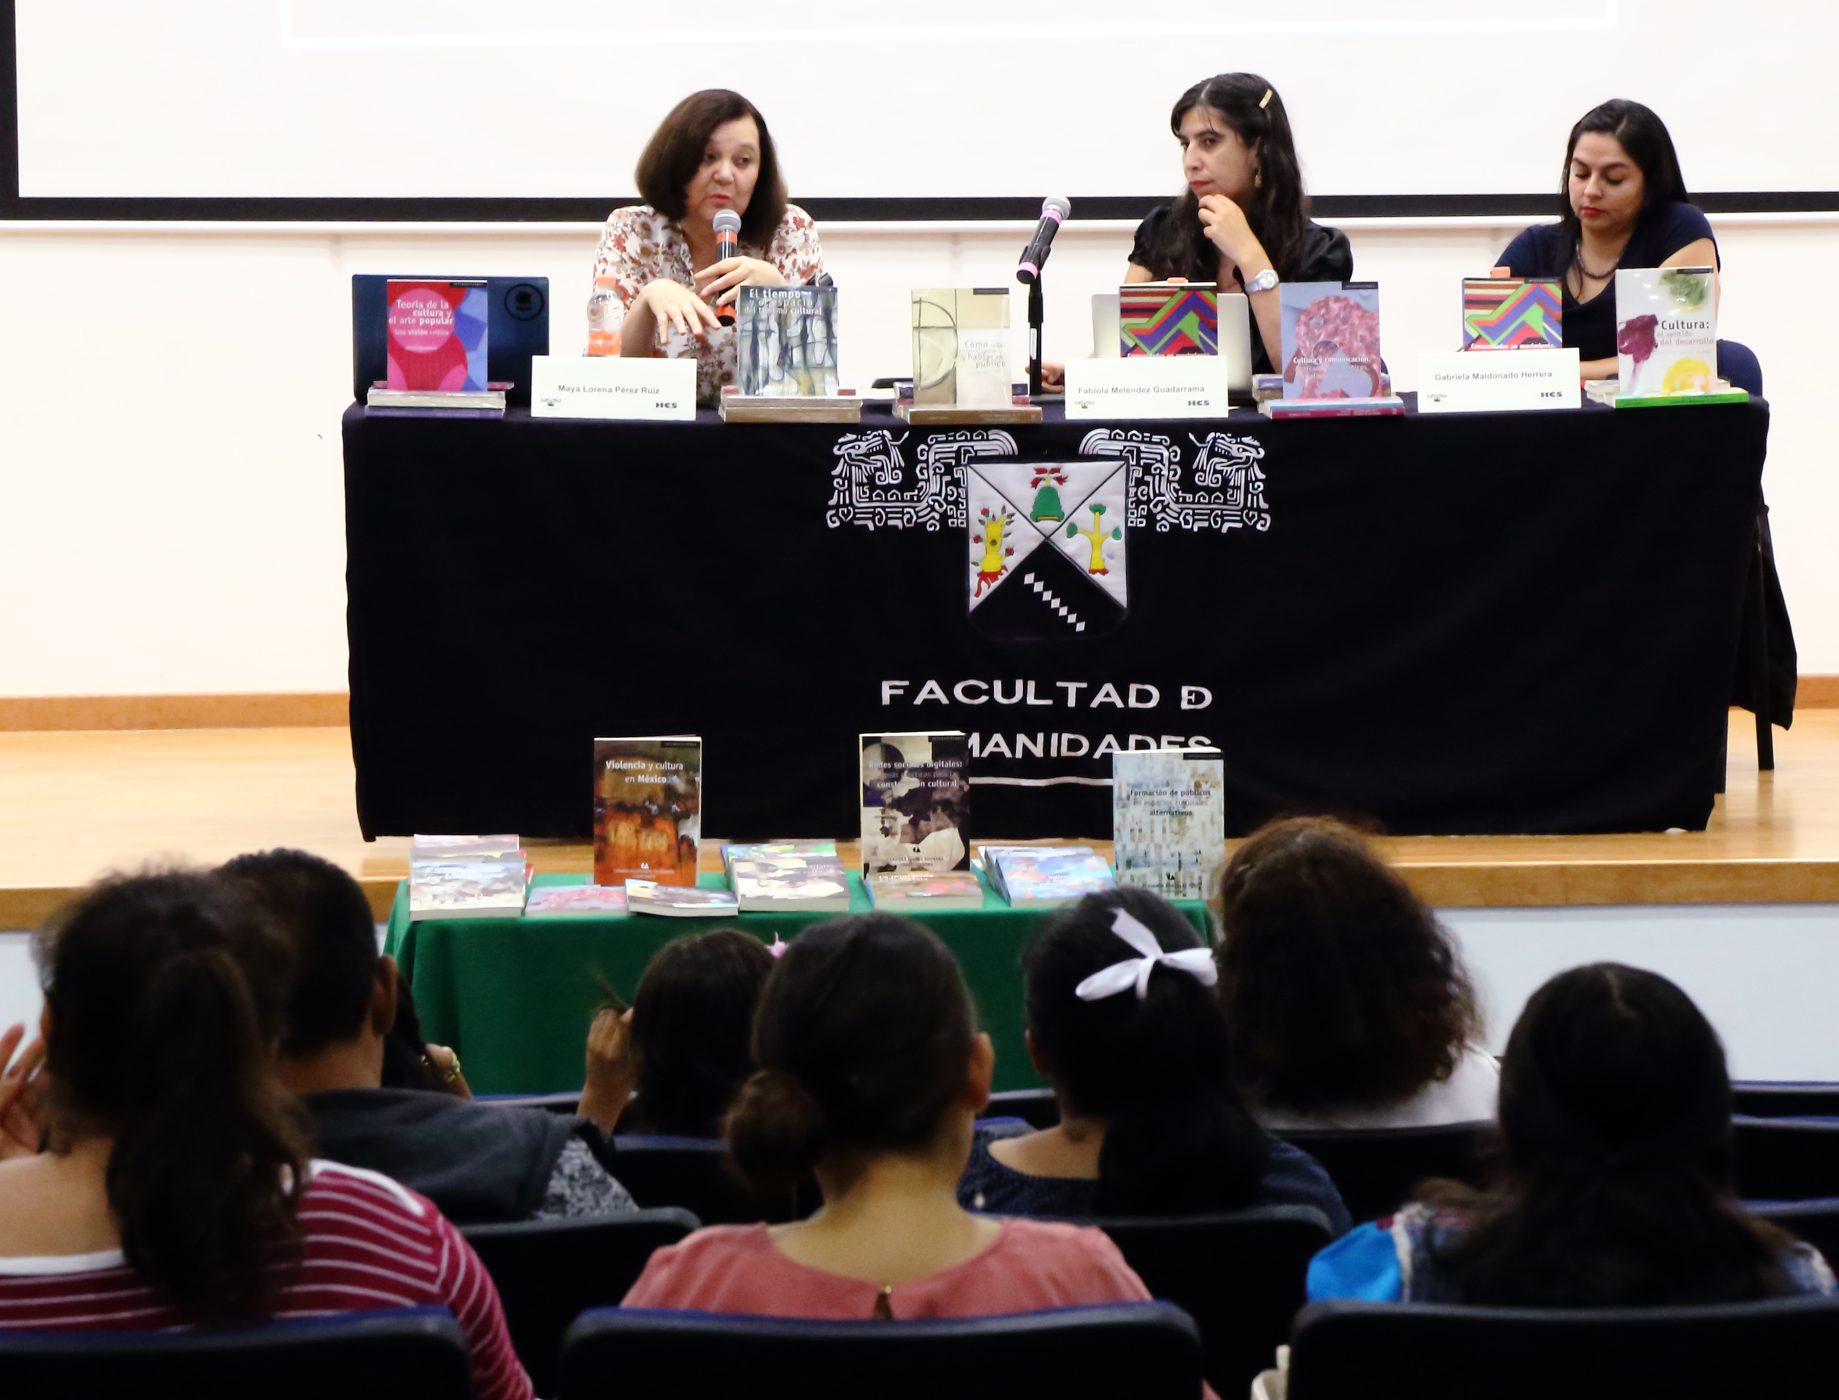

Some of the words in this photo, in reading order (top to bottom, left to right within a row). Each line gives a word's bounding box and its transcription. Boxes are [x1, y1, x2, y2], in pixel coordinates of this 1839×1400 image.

[749, 289, 758, 298] El
[763, 289, 801, 300] tiempo
[396, 299, 424, 309] Teoría
[426, 300, 437, 309] de
[440, 300, 449, 309] la
[413, 308, 444, 317] cultura
[446, 310, 452, 319] y
[790, 307, 822, 315] cultural
[388, 316, 397, 325] el
[400, 317, 417, 325] arte
[419, 317, 454, 326] popular
[1661, 320, 1710, 330] Cultura:
[1435, 373, 1470, 381] Gabriela
[1472, 372, 1519, 380] Maldonado
[1521, 371, 1553, 379] Herrera
[558, 385, 581, 394] Maya
[583, 386, 613, 394] Lorena
[615, 386, 639, 394] Pérez
[641, 387, 660, 395] Ruiz
[1111, 386, 1150, 394] Meléndez
[1153, 385, 1205, 394] Guadarrama
[881, 679, 1160, 709] FACULTAD
[606, 760, 646, 770] Violencia
[648, 763, 654, 771] y
[655, 761, 684, 770] cultura
[638, 774, 667, 783] México
[927, 780, 957, 788] cultural
